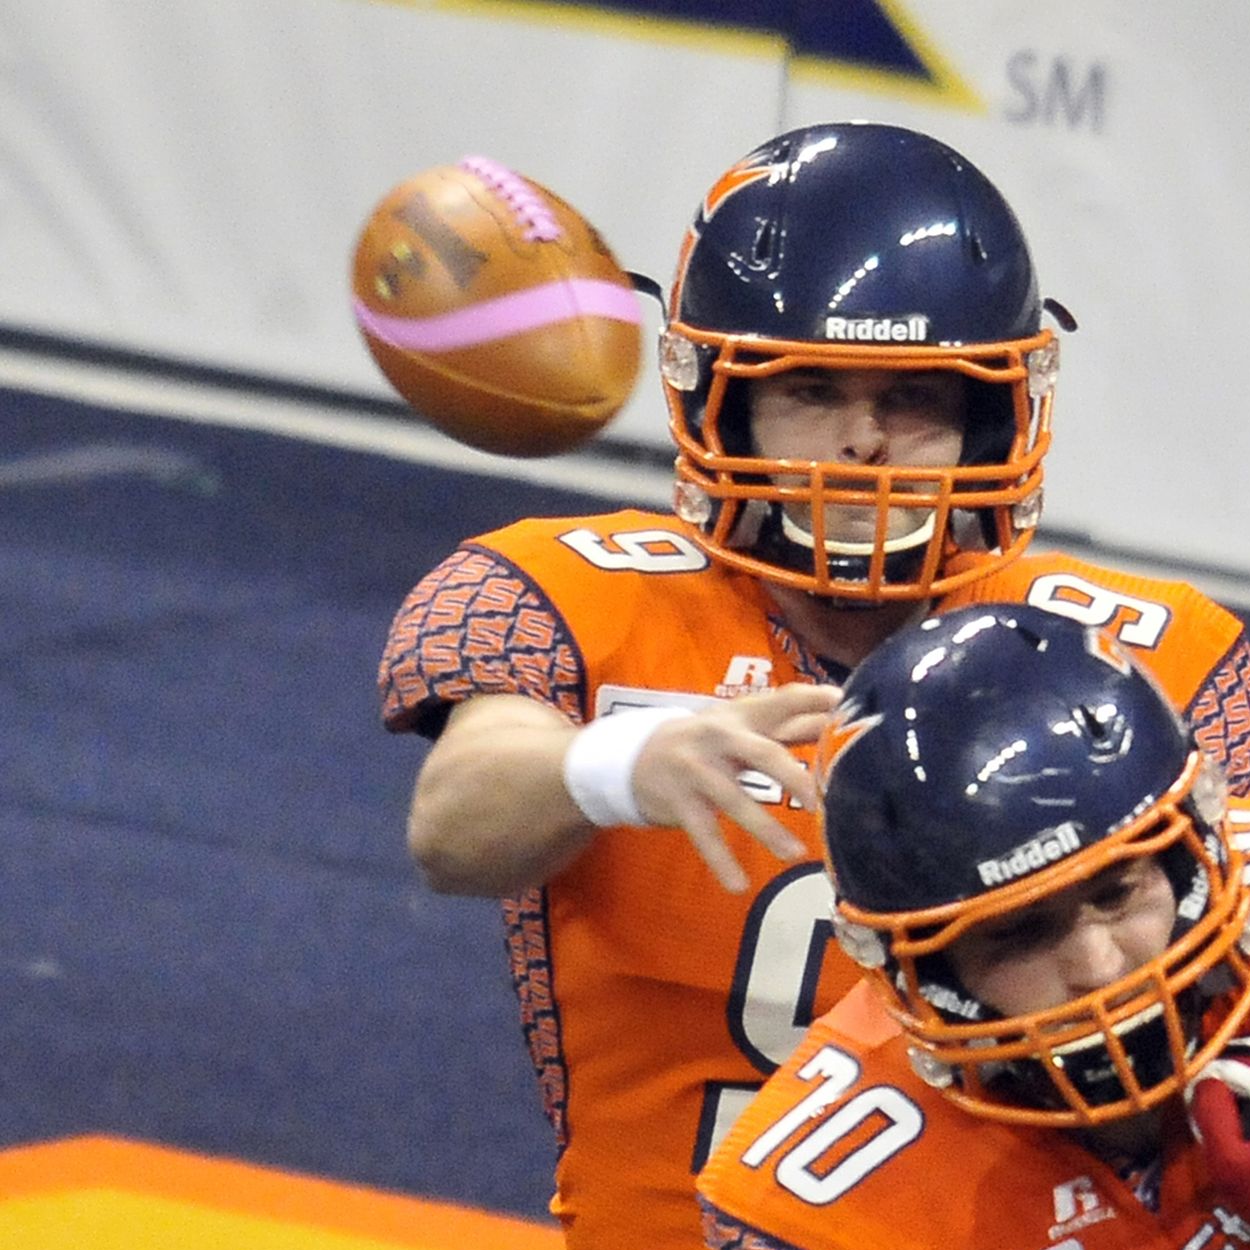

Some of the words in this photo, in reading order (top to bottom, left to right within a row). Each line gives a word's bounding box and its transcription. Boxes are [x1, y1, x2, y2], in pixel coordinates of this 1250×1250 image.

[1004, 50, 1104, 132] SM
[825, 316, 927, 341] Riddell
[1026, 573, 1172, 651] 9
[977, 821, 1082, 886] Riddell
[740, 1044, 926, 1206] 70
